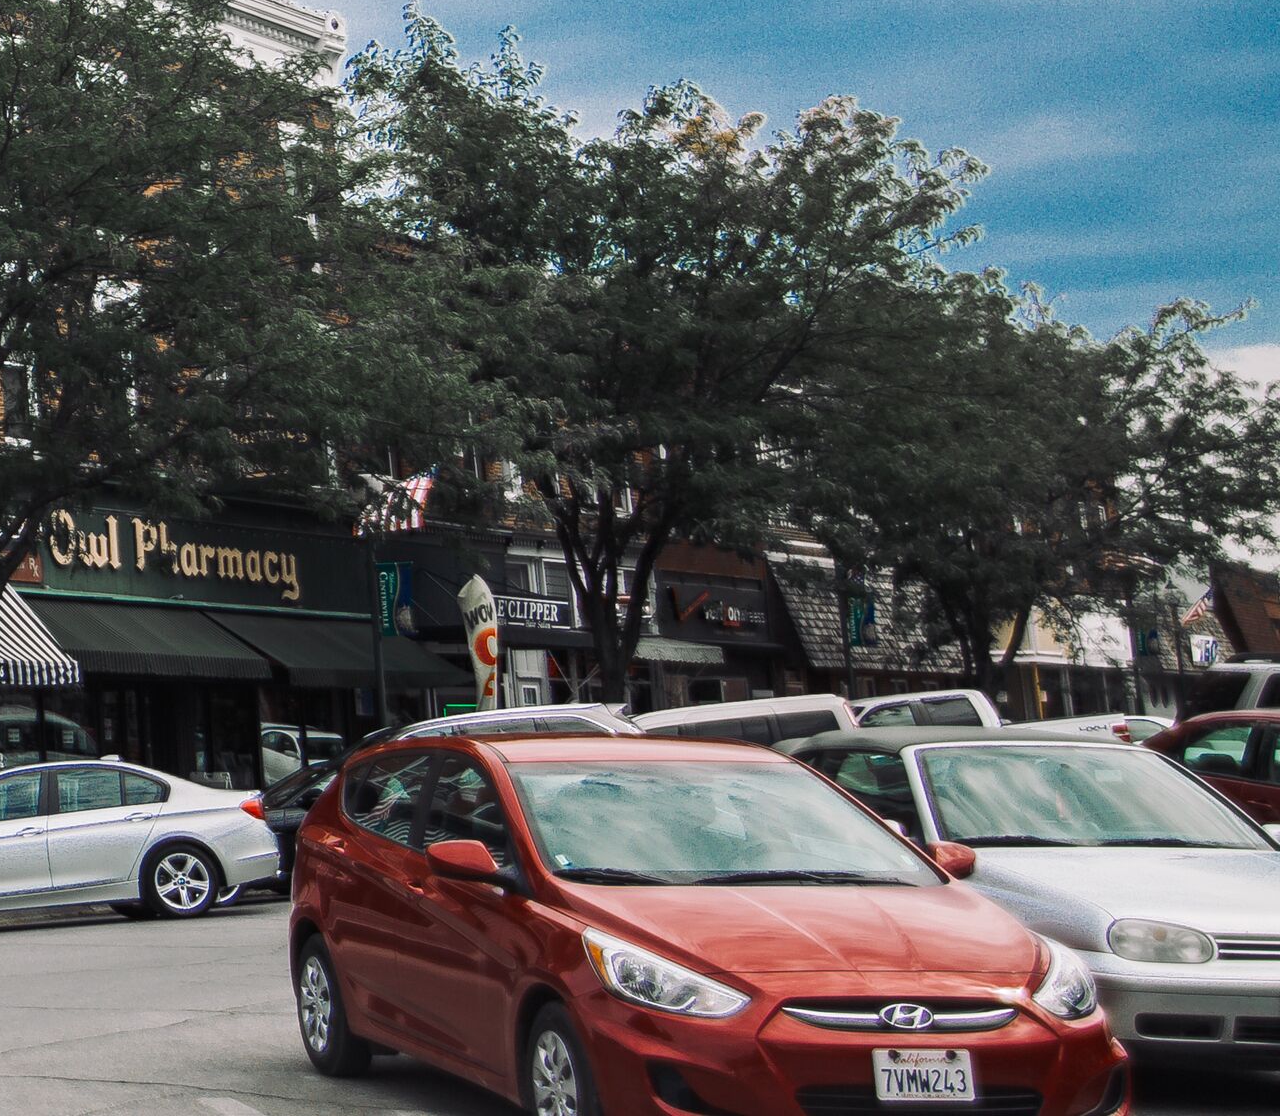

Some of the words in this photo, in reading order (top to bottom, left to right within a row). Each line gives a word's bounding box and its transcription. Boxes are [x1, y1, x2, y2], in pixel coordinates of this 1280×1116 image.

[49, 508, 122, 570] Owl
[132, 516, 301, 601] Pharmacy
[880, 1068, 968, 1094] 7VMW243
